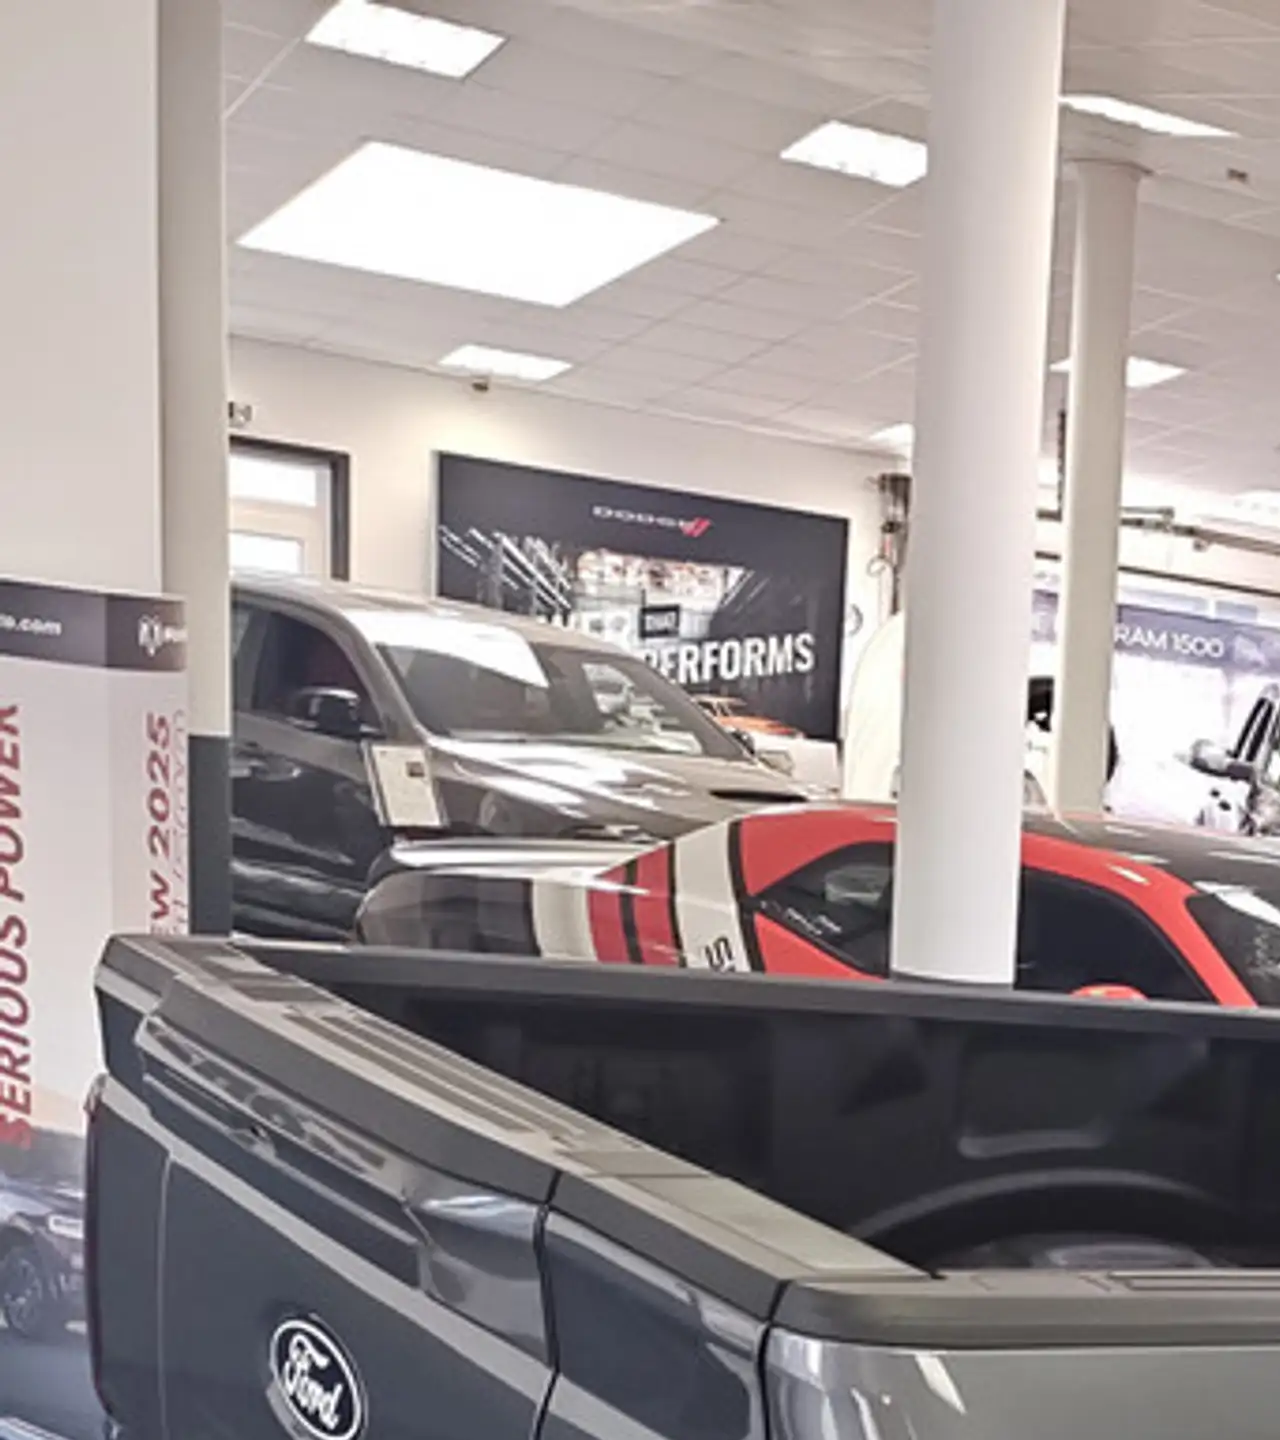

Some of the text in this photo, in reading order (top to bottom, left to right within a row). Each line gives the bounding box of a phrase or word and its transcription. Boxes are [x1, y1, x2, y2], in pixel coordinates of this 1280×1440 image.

[640, 633, 816, 685] PERFORMS
[1114, 622, 1225, 659] RAM 1500
[148, 711, 170, 861] 2025
[283, 1333, 343, 1431] Ford
